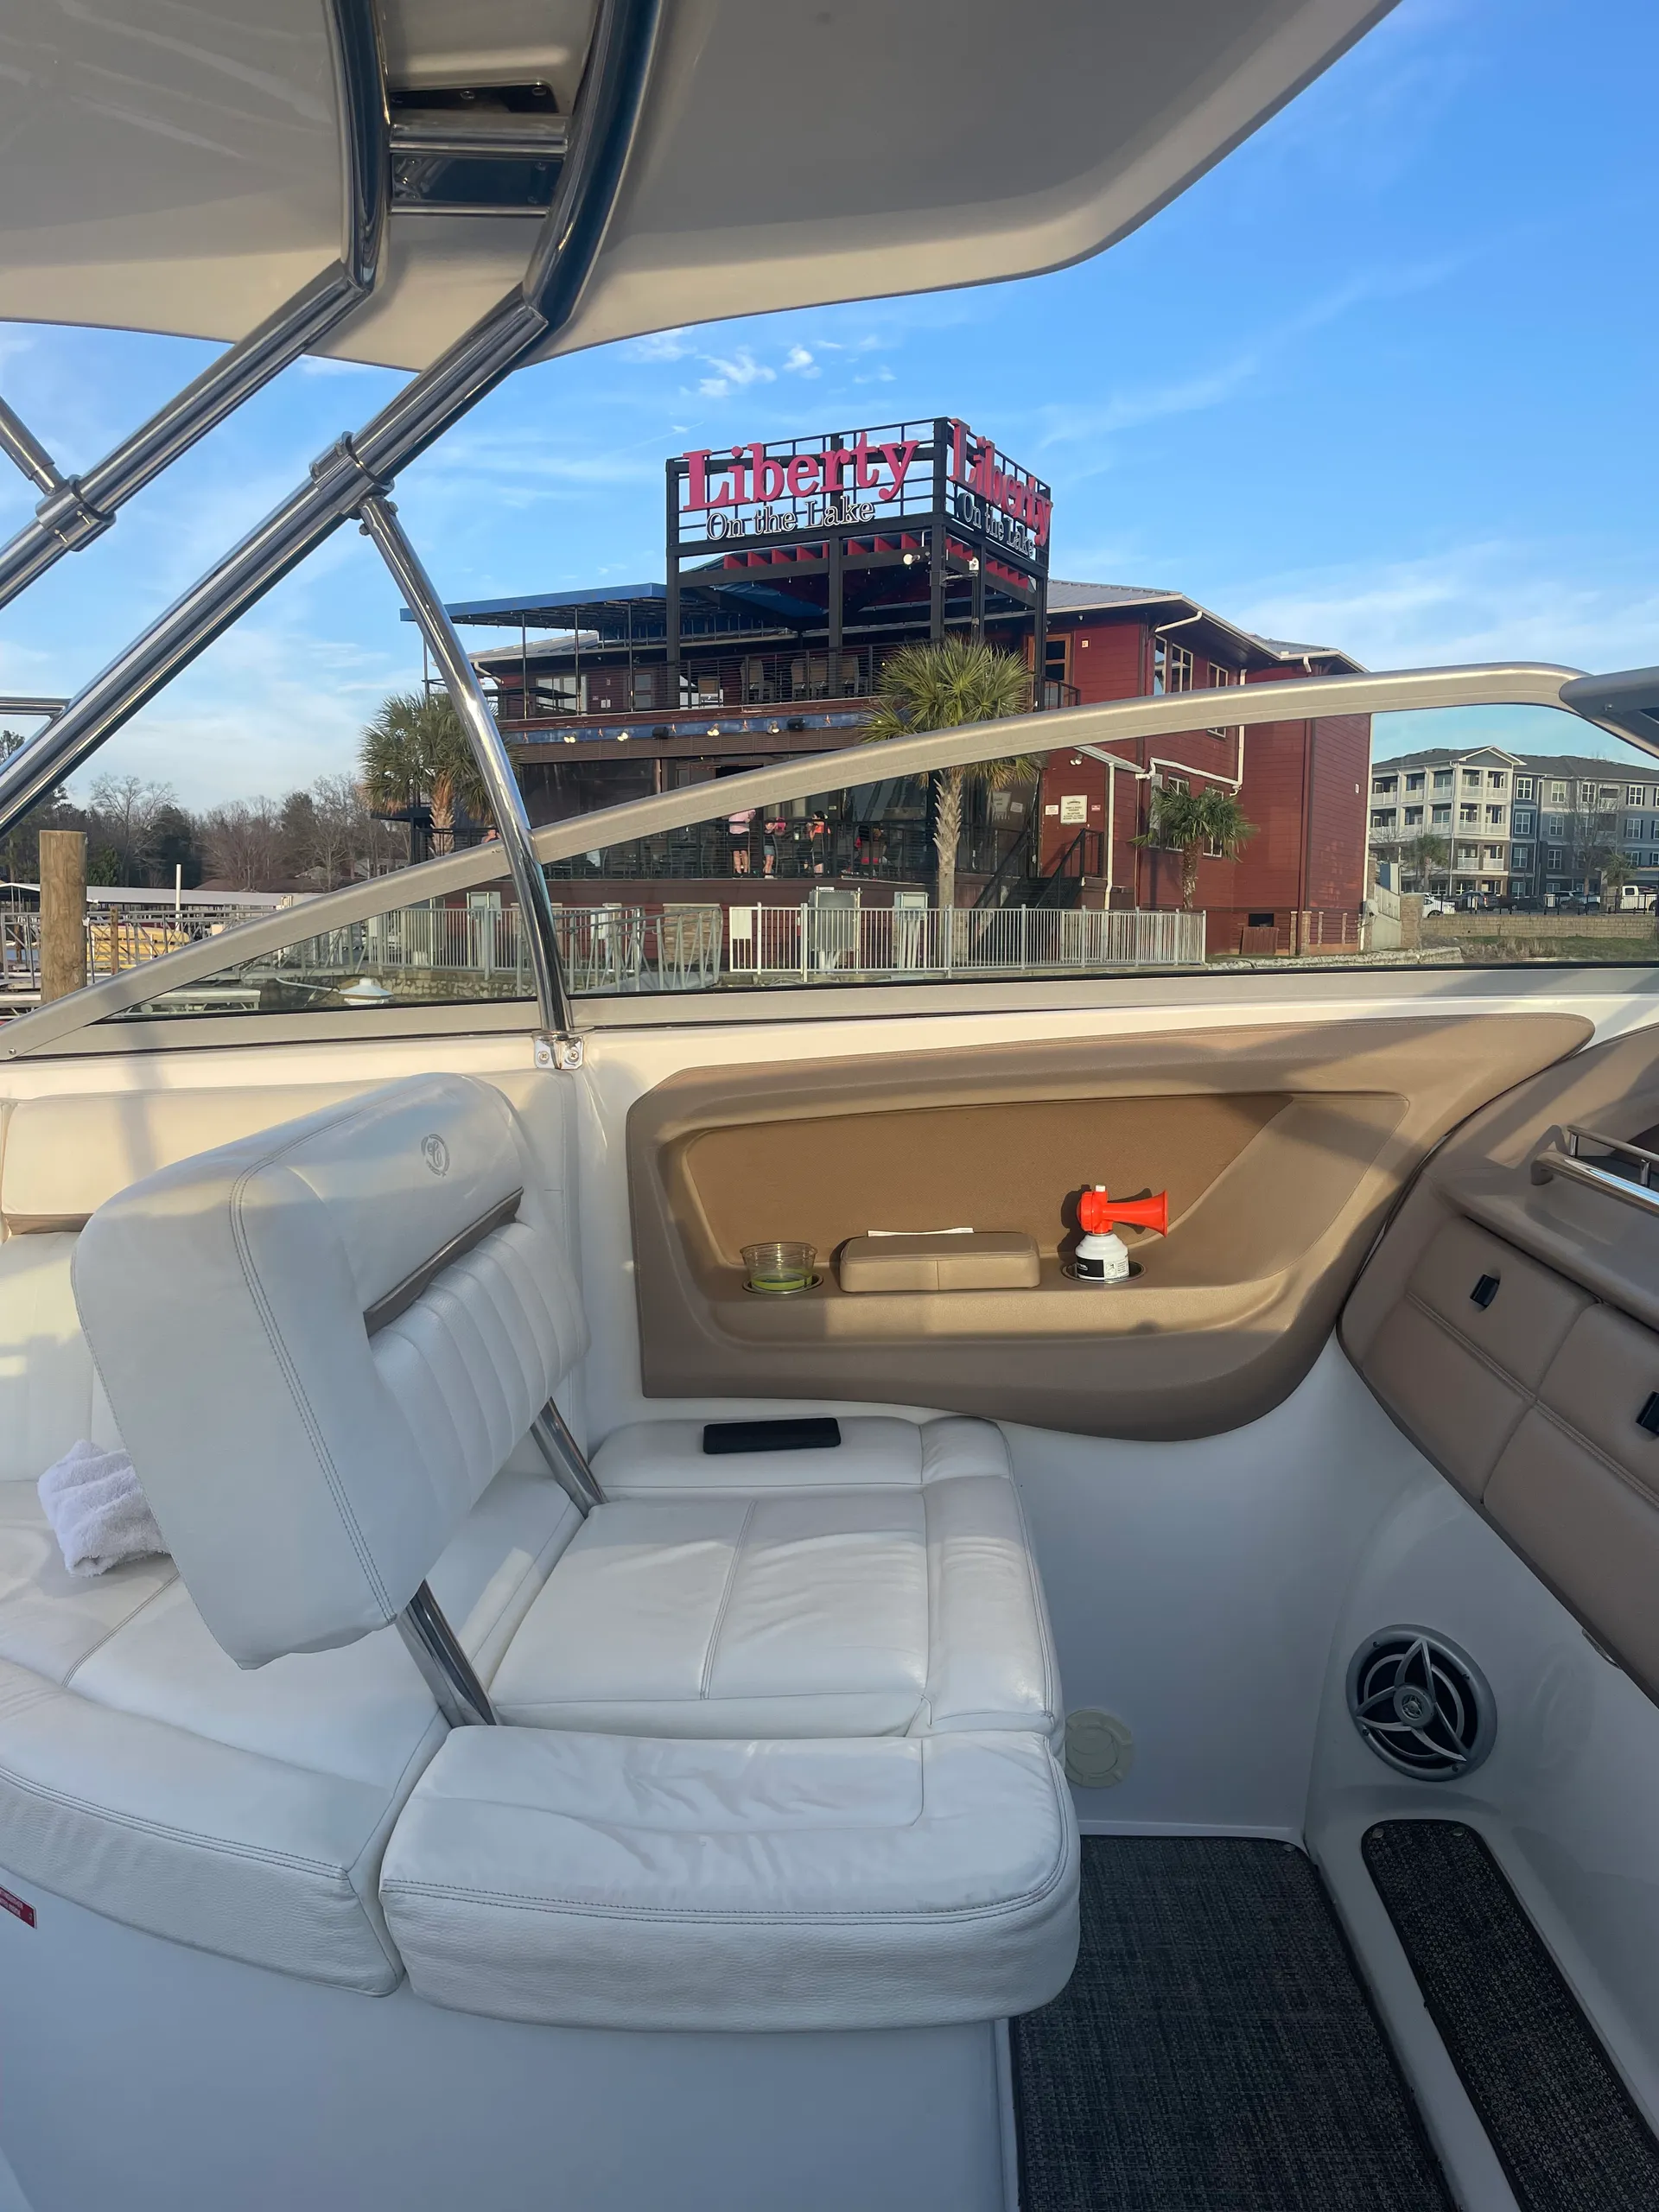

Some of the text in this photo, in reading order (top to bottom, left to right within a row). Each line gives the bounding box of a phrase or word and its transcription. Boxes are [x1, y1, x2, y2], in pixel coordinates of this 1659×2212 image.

[683, 431, 919, 511] Liberty
[949, 418, 1053, 546] Liberty
[707, 495, 874, 540] On the Lake
[962, 493, 1035, 557] On the Lake
